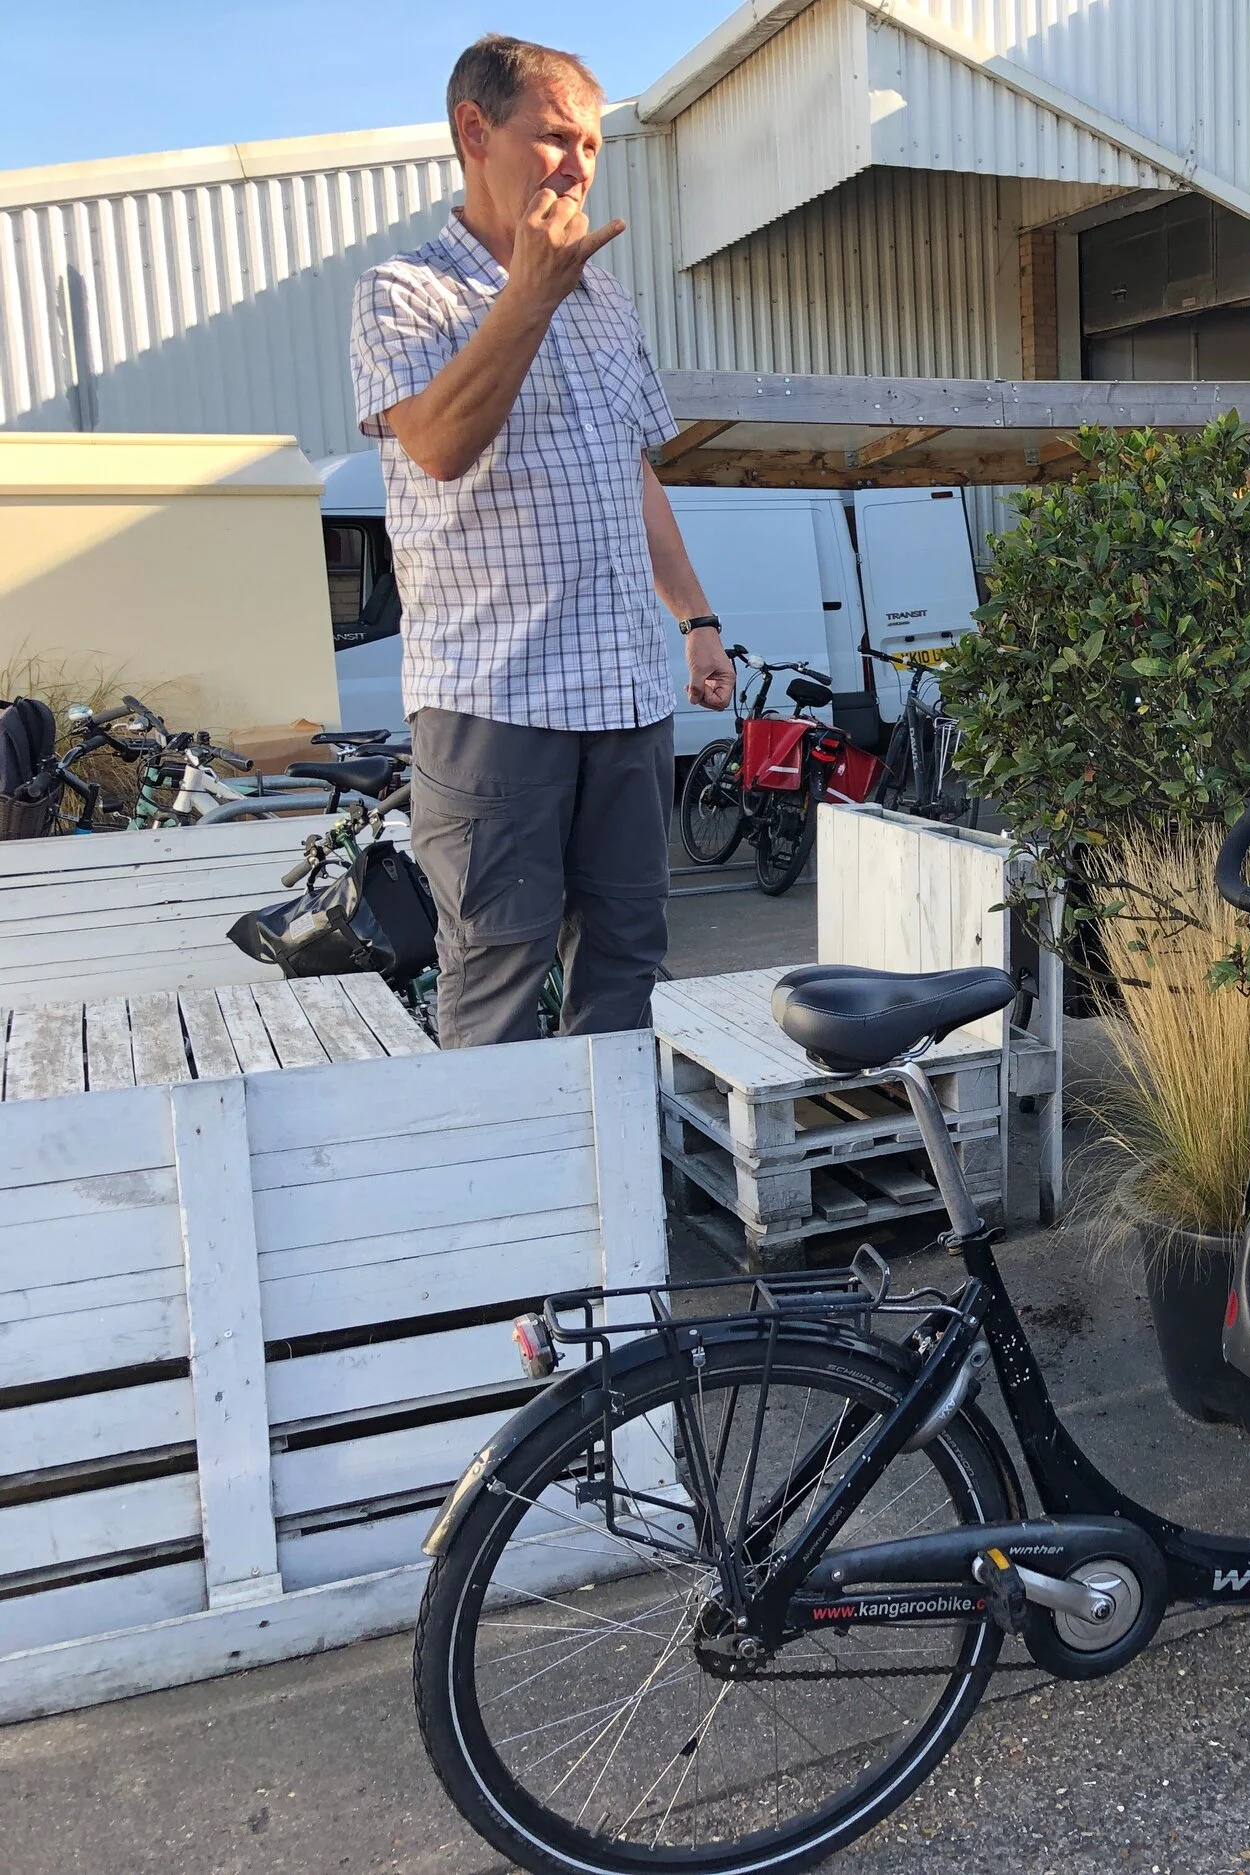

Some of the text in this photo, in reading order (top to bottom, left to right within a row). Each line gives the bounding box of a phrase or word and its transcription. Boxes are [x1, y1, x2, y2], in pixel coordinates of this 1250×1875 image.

[885, 609, 928, 621] TRANSIT
[1009, 1545, 1065, 1556] winther
[812, 1597, 985, 1620] www.kangaroobike.c
